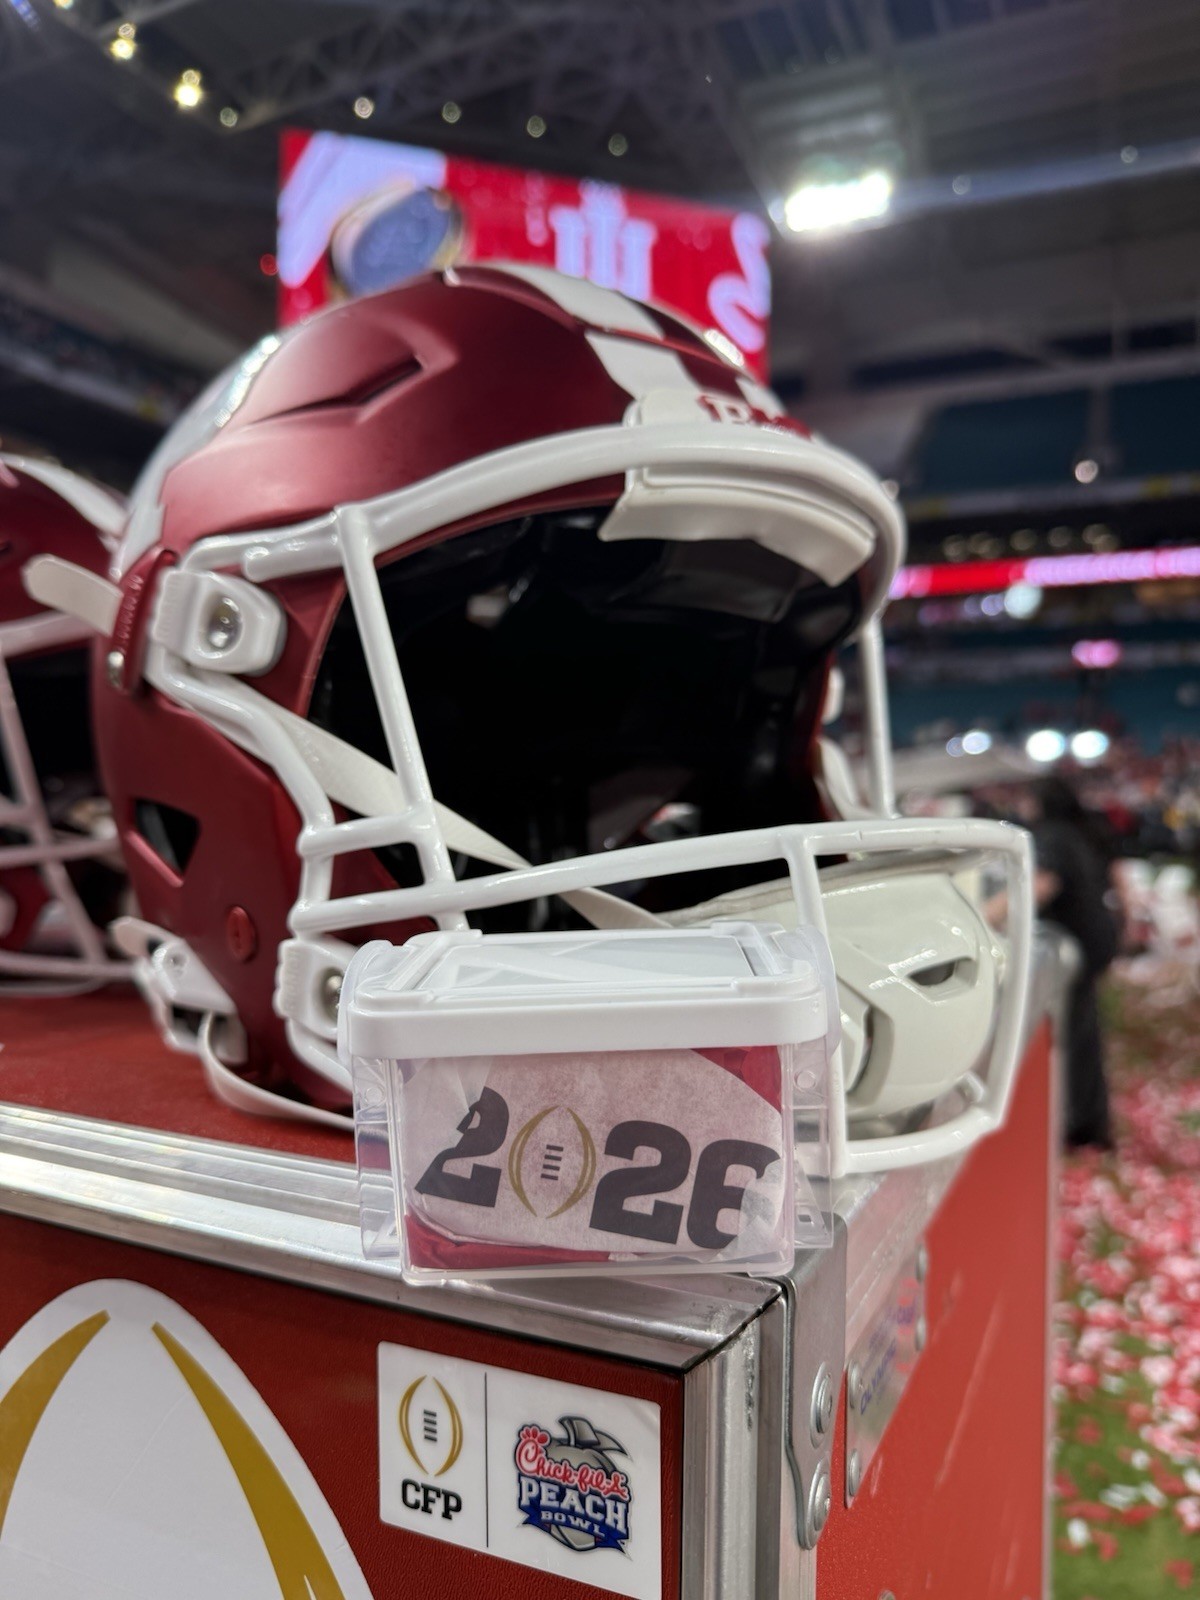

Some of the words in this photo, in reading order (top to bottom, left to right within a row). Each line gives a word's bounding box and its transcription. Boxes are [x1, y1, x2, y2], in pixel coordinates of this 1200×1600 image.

[401, 1478, 463, 1521] CFP
[520, 1476, 628, 1534] PEACH
[540, 1510, 606, 1538] BOWL
